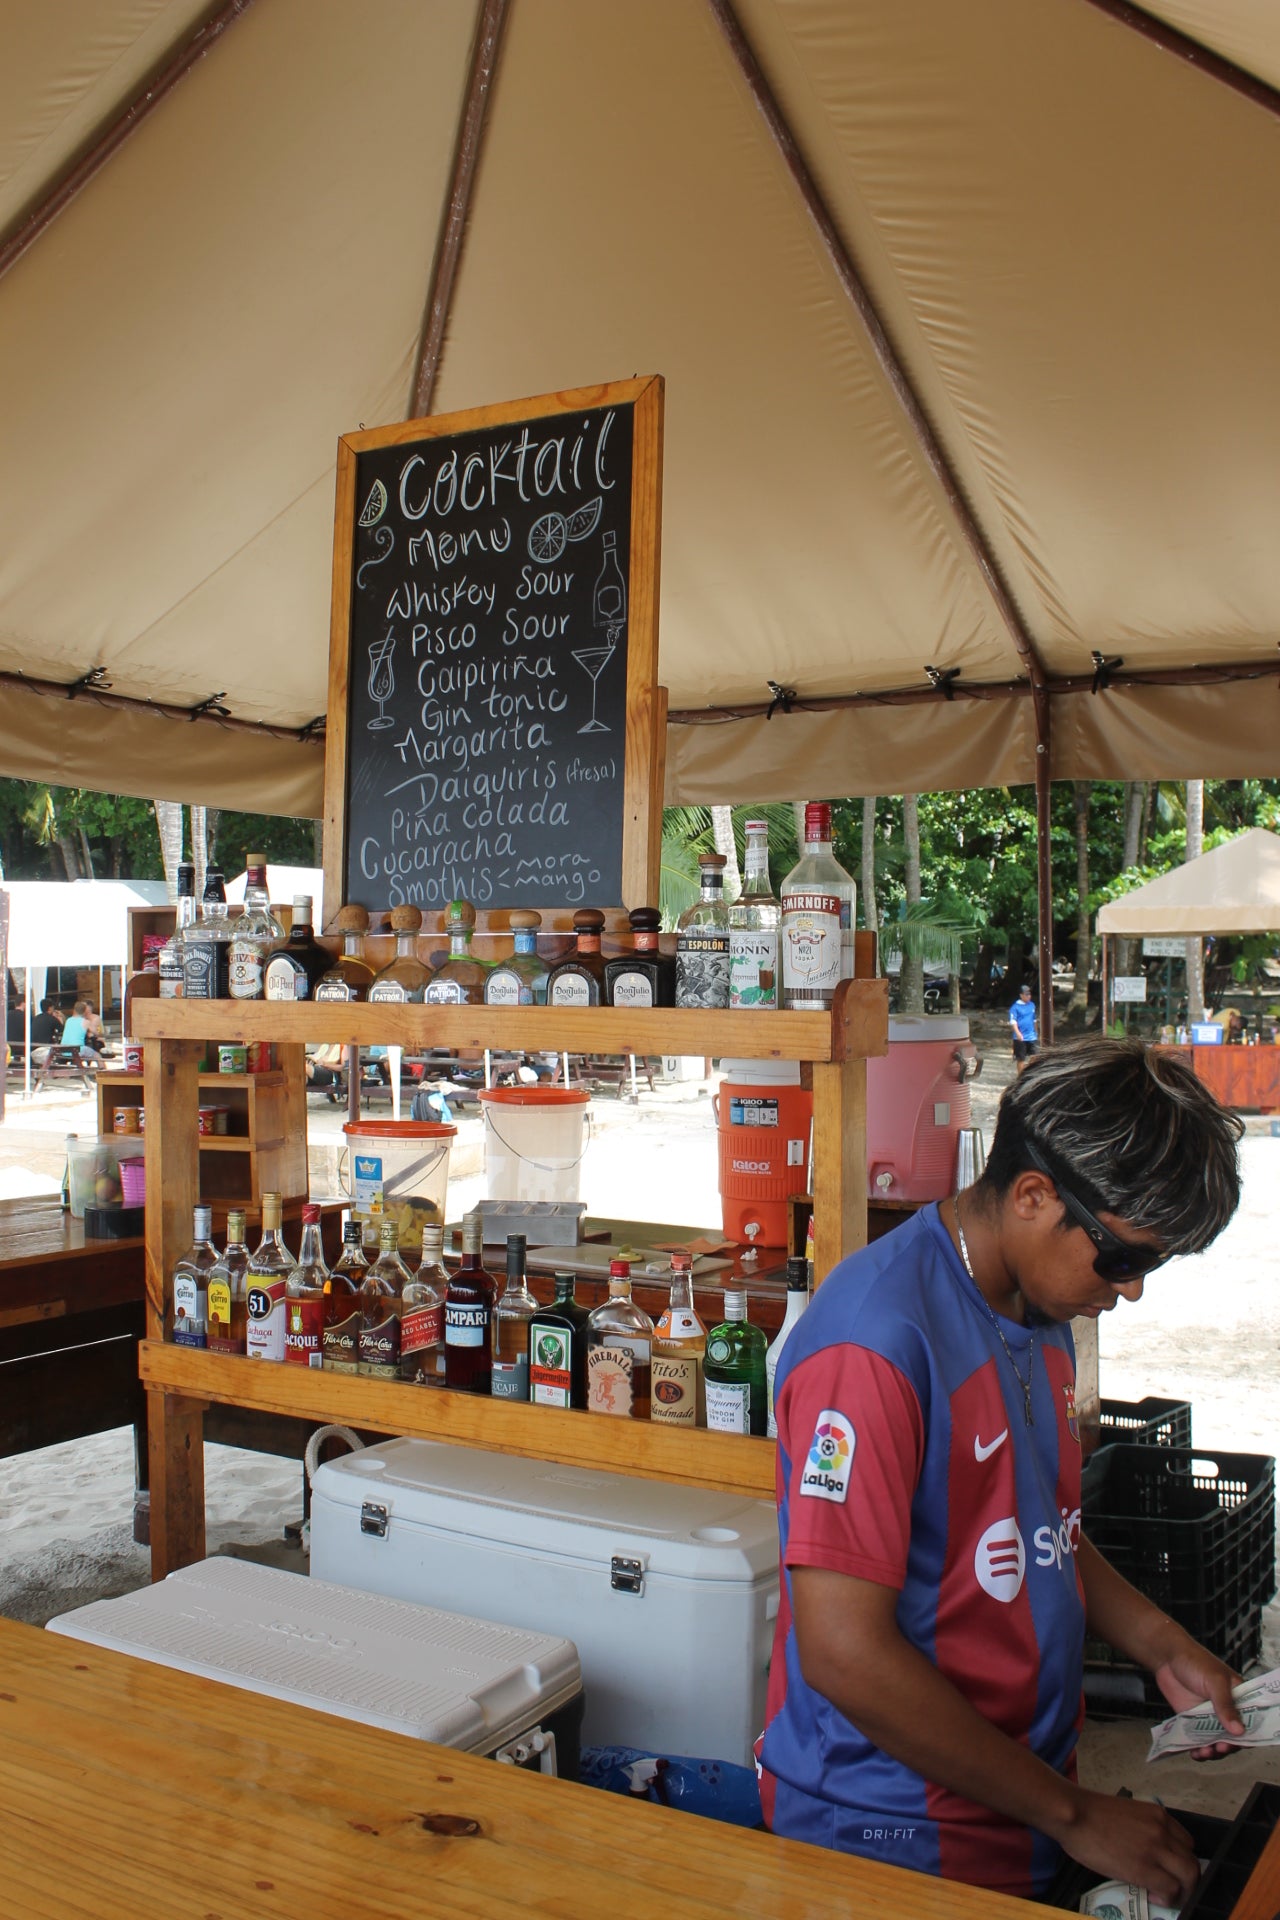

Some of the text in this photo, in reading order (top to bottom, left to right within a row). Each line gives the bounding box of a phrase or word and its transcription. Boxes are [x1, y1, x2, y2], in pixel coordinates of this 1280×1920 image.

[399, 410, 616, 520] Cocktail
[408, 517, 512, 571] Menu
[386, 564, 575, 620] Whiskey Sour
[411, 607, 570, 657] Pisco Sour
[417, 654, 557, 702] Caipiriña
[421, 684, 568, 736] Gin tonic
[393, 719, 553, 773] Margarita
[384, 755, 616, 817] Daiquiris (fresa)
[391, 807, 450, 845] Piña
[360, 831, 517, 880] Cucaracha
[388, 866, 493, 910] Smothis
[783, 896, 835, 911] SMIRNOFF
[230, 953, 258, 964] CHIVAS
[268, 976, 279, 990] Old
[732, 1160, 770, 1171] IGLOO
[249, 1294, 265, 1313] 51
[445, 1309, 488, 1326] AMPARI
[248, 1325, 272, 1338] achaça
[401, 1327, 414, 1336] RED
[415, 1320, 438, 1331] LABEL
[284, 1333, 318, 1348] ACIQUE
[588, 1351, 631, 1373] FIREBALL
[652, 1361, 688, 1379] Tito's
[651, 1403, 694, 1419] Handmade
[803, 1473, 844, 1492] LaLiga
[863, 1828, 916, 1840] DRI-FIT
